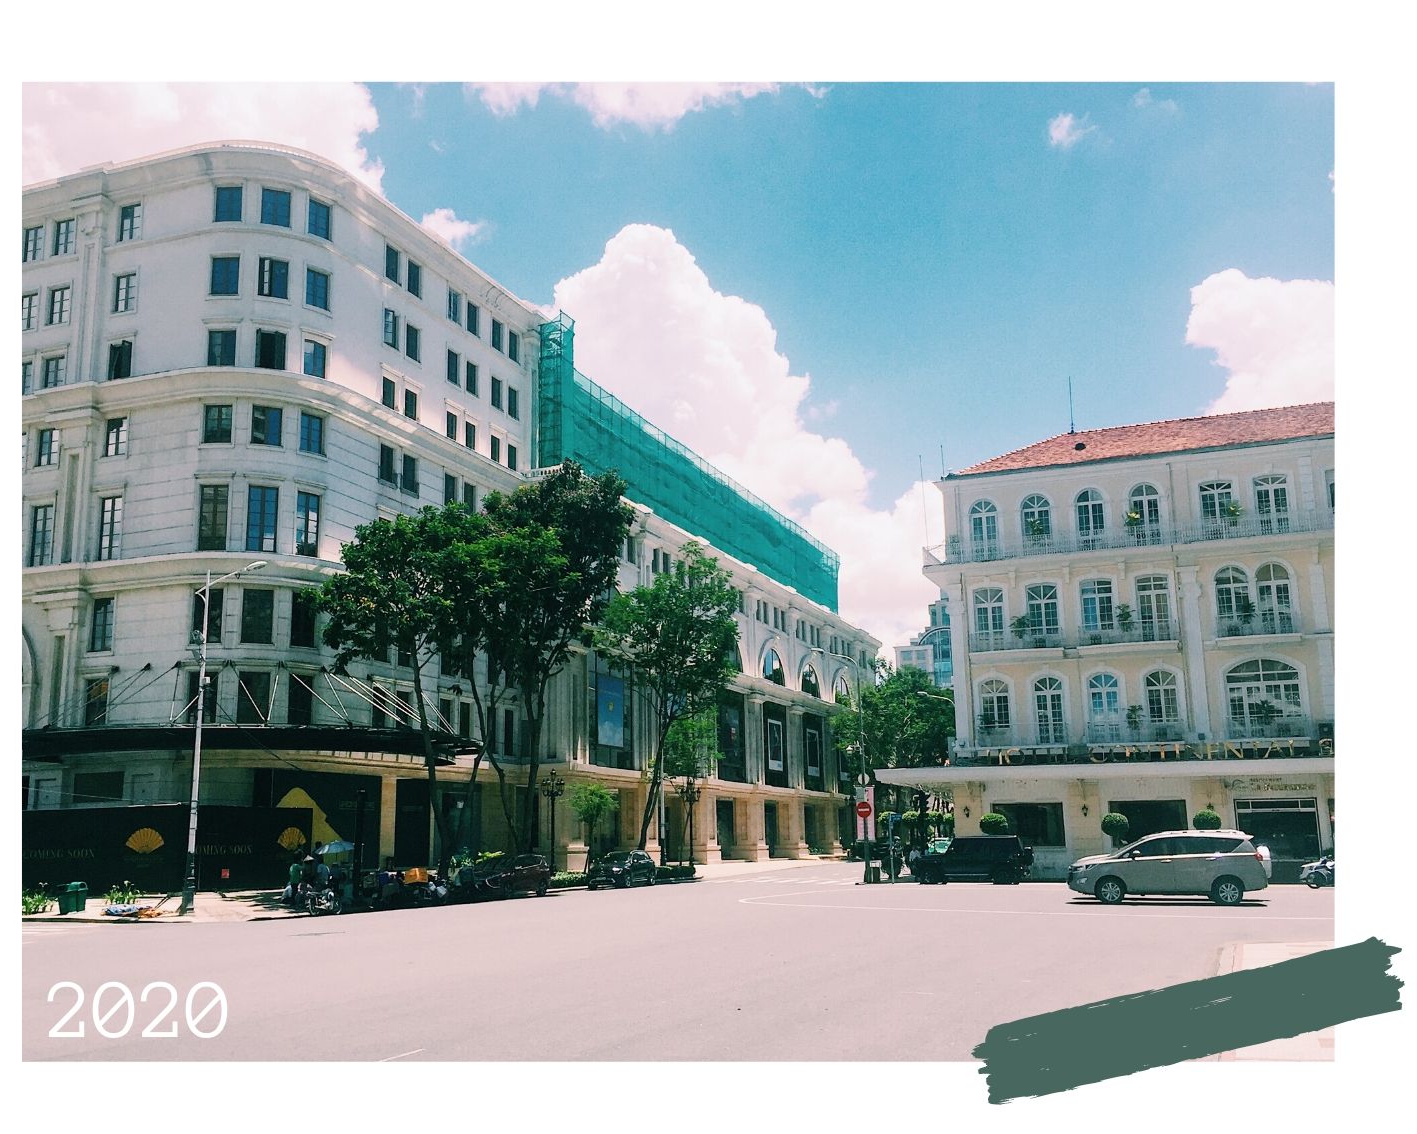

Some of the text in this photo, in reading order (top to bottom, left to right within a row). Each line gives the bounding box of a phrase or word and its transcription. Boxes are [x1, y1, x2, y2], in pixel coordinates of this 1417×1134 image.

[1089, 739, 1303, 763] CONTINENTAL
[67, 847, 95, 859] SOON
[195, 845, 227, 856] OMING
